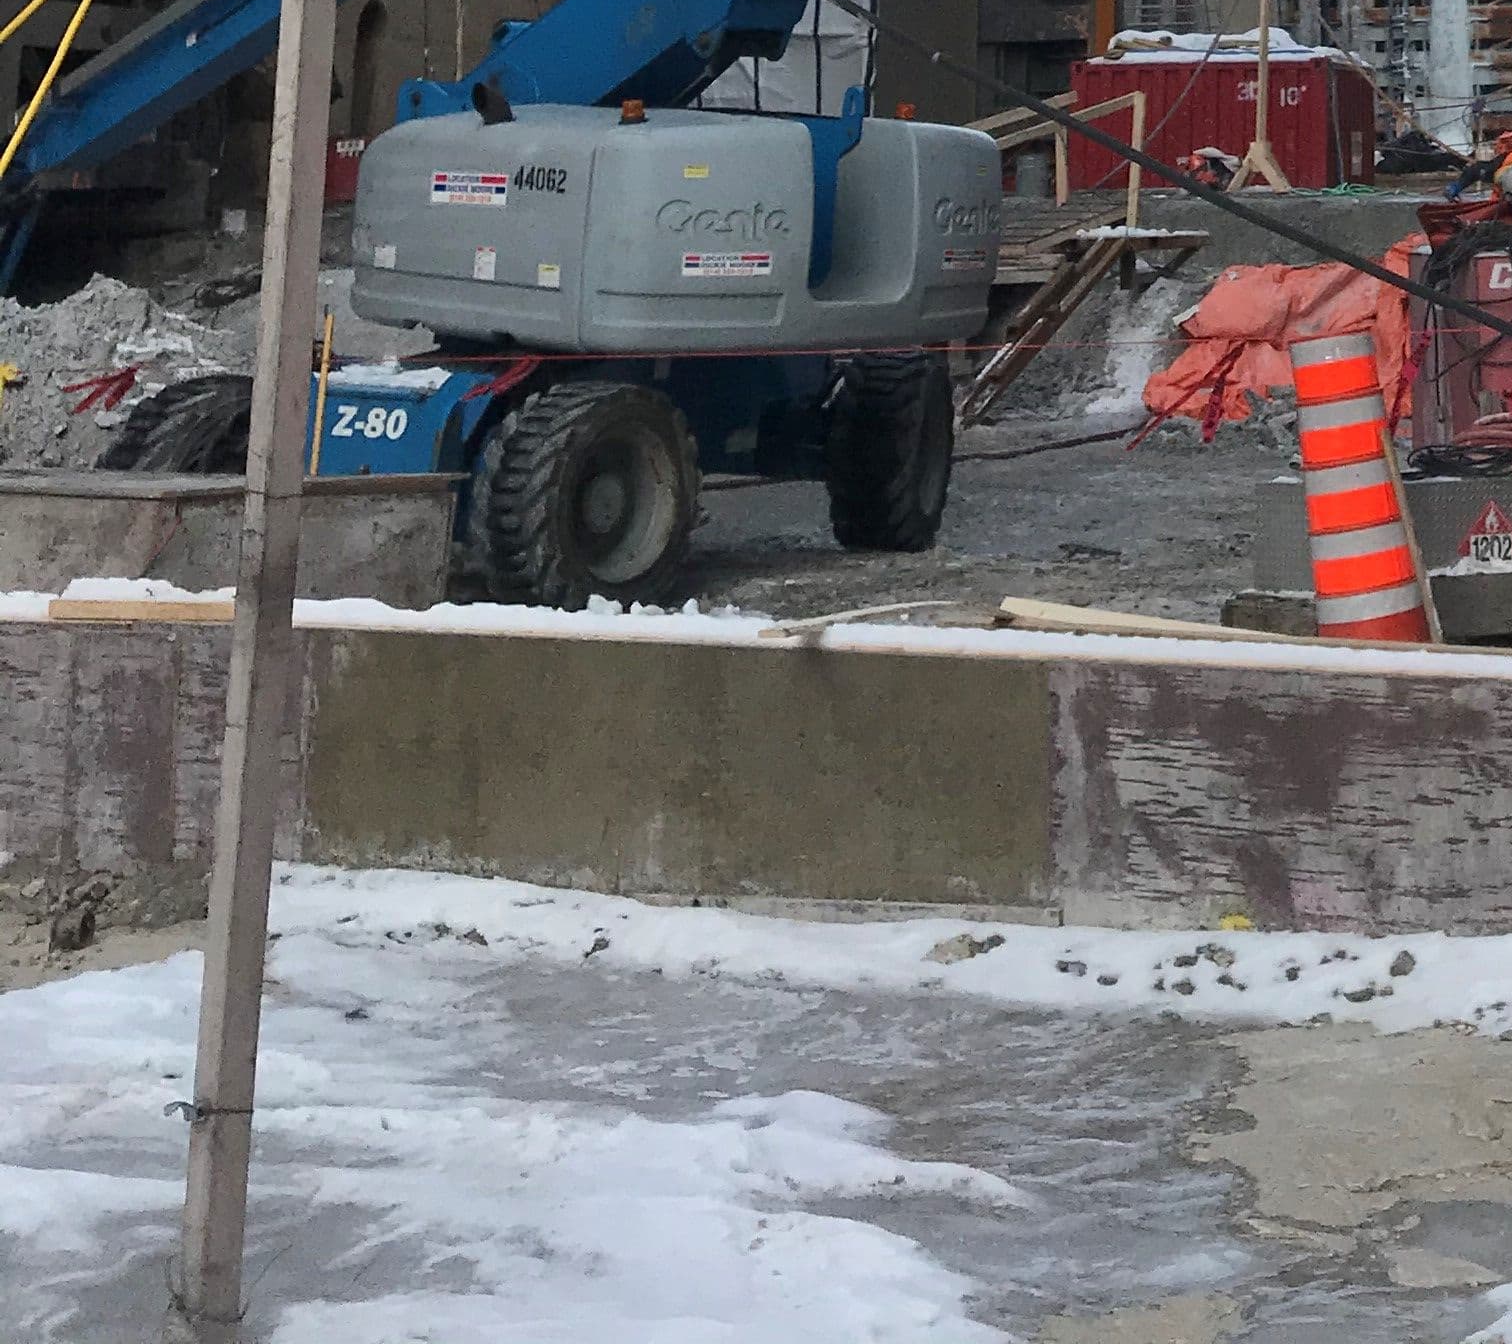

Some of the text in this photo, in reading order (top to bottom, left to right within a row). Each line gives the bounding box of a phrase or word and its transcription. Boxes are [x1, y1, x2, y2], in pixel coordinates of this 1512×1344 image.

[514, 165, 567, 193] 44062
[655, 199, 789, 237] Genie
[331, 405, 408, 440] Z-80
[1472, 535, 1512, 562] 1202
